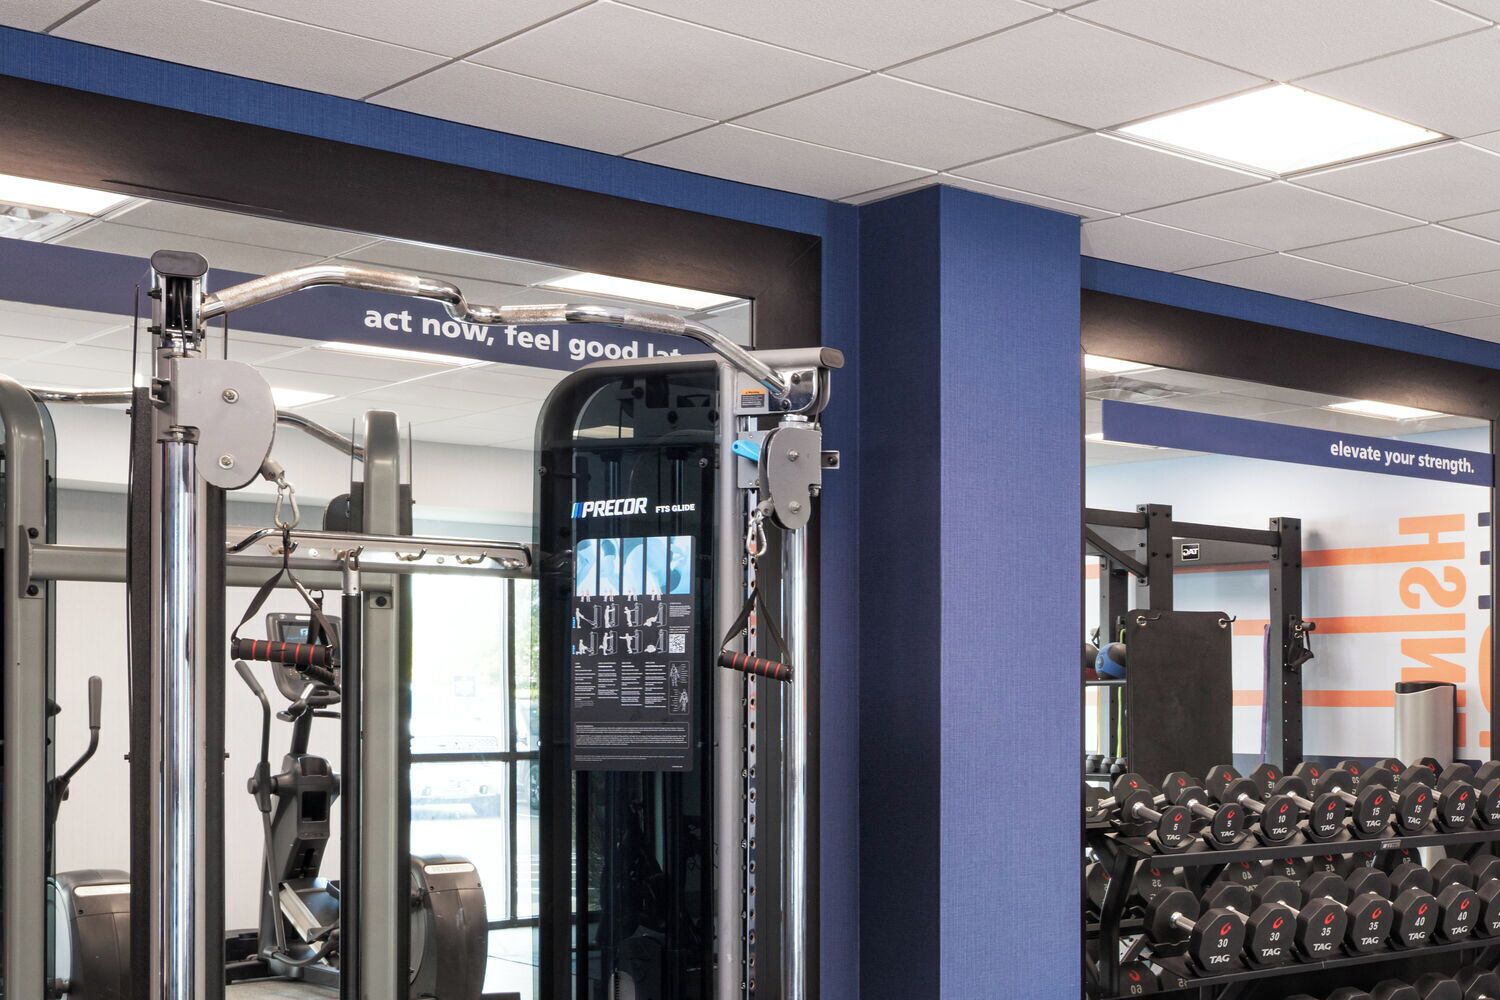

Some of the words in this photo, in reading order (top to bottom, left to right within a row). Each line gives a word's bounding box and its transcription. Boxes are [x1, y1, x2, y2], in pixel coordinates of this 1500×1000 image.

[364, 308, 412, 333] act
[422, 318, 495, 346] now,
[505, 324, 559, 352] feel
[568, 338, 639, 361] good
[1330, 440, 1381, 461] elevate
[1384, 450, 1415, 466] your
[1418, 453, 1475, 475] strength.
[582, 497, 648, 518] PRECOR
[655, 505, 671, 514] FTS
[671, 503, 696, 513] GLIDE
[1372, 807, 1381, 816] 15
[1414, 804, 1423, 814] 15
[1456, 802, 1466, 811] 20
[1278, 815, 1287, 824] 10
[1326, 812, 1334, 821] 10
[1407, 816, 1421, 825] TAG
[1173, 823, 1179, 831] 5
[1227, 820, 1232, 828] 5
[1320, 823, 1336, 832] TAG
[1272, 827, 1288, 835] TAG
[1457, 911, 1468, 921] 40
[1368, 921, 1379, 931] 35
[1415, 917, 1425, 927] 40
[1320, 927, 1332, 936] 35
[1408, 931, 1426, 941] TAG
[1451, 926, 1468, 936] TAG
[1269, 932, 1280, 941] 30
[1361, 936, 1380, 946] TAG
[1217, 938, 1228, 948] 30
[1313, 942, 1333, 952] TAG
[1261, 947, 1281, 957] TAG
[1209, 954, 1230, 964] TAG
